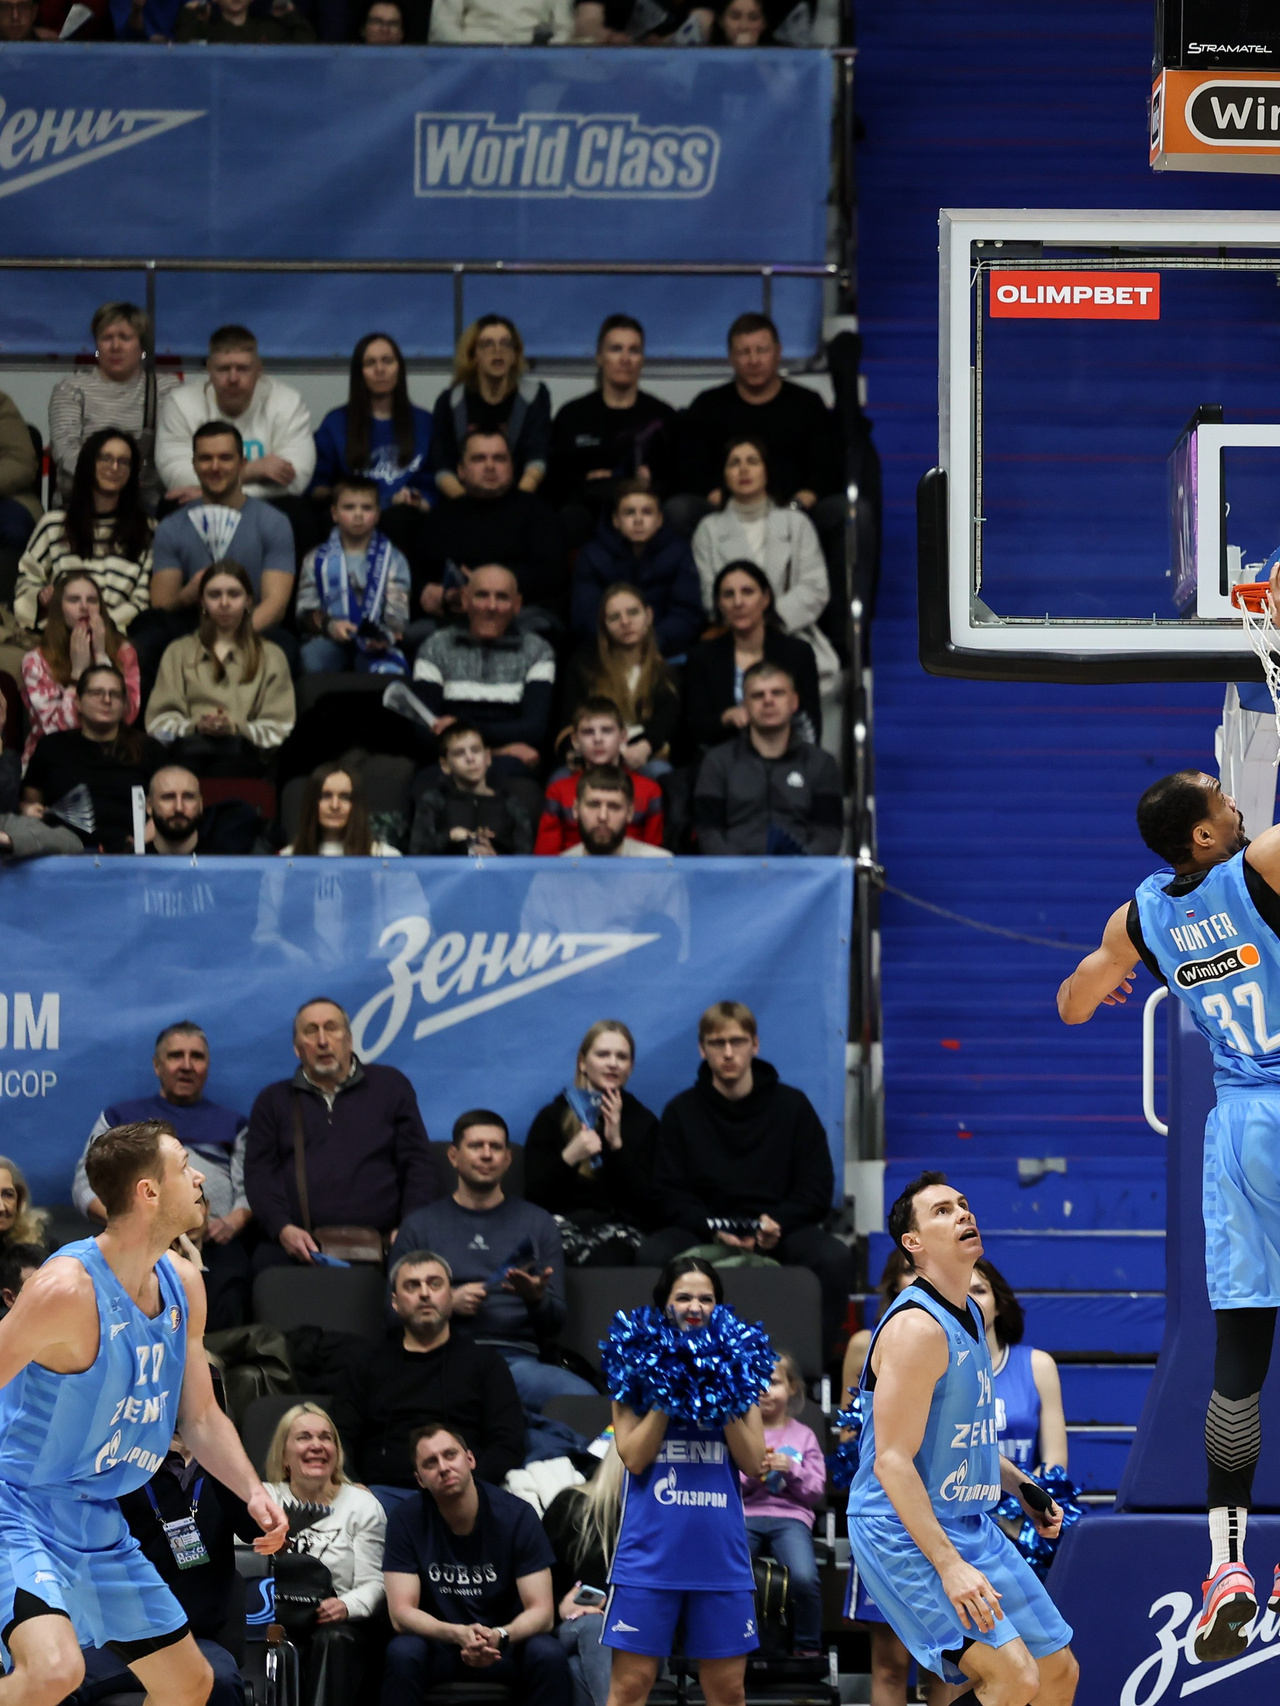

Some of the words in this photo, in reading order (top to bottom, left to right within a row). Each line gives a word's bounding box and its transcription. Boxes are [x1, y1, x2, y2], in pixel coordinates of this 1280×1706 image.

[426, 123, 570, 187] World
[574, 124, 709, 189] Class
[996, 284, 1154, 306] OLIMPBET
[1169, 912, 1239, 952] HUNTER
[1182, 956, 1238, 984] Winline
[976, 1368, 992, 1408] 24
[676, 1490, 728, 1508] ГАЗПРОМ
[428, 1562, 498, 1584] GUESS
